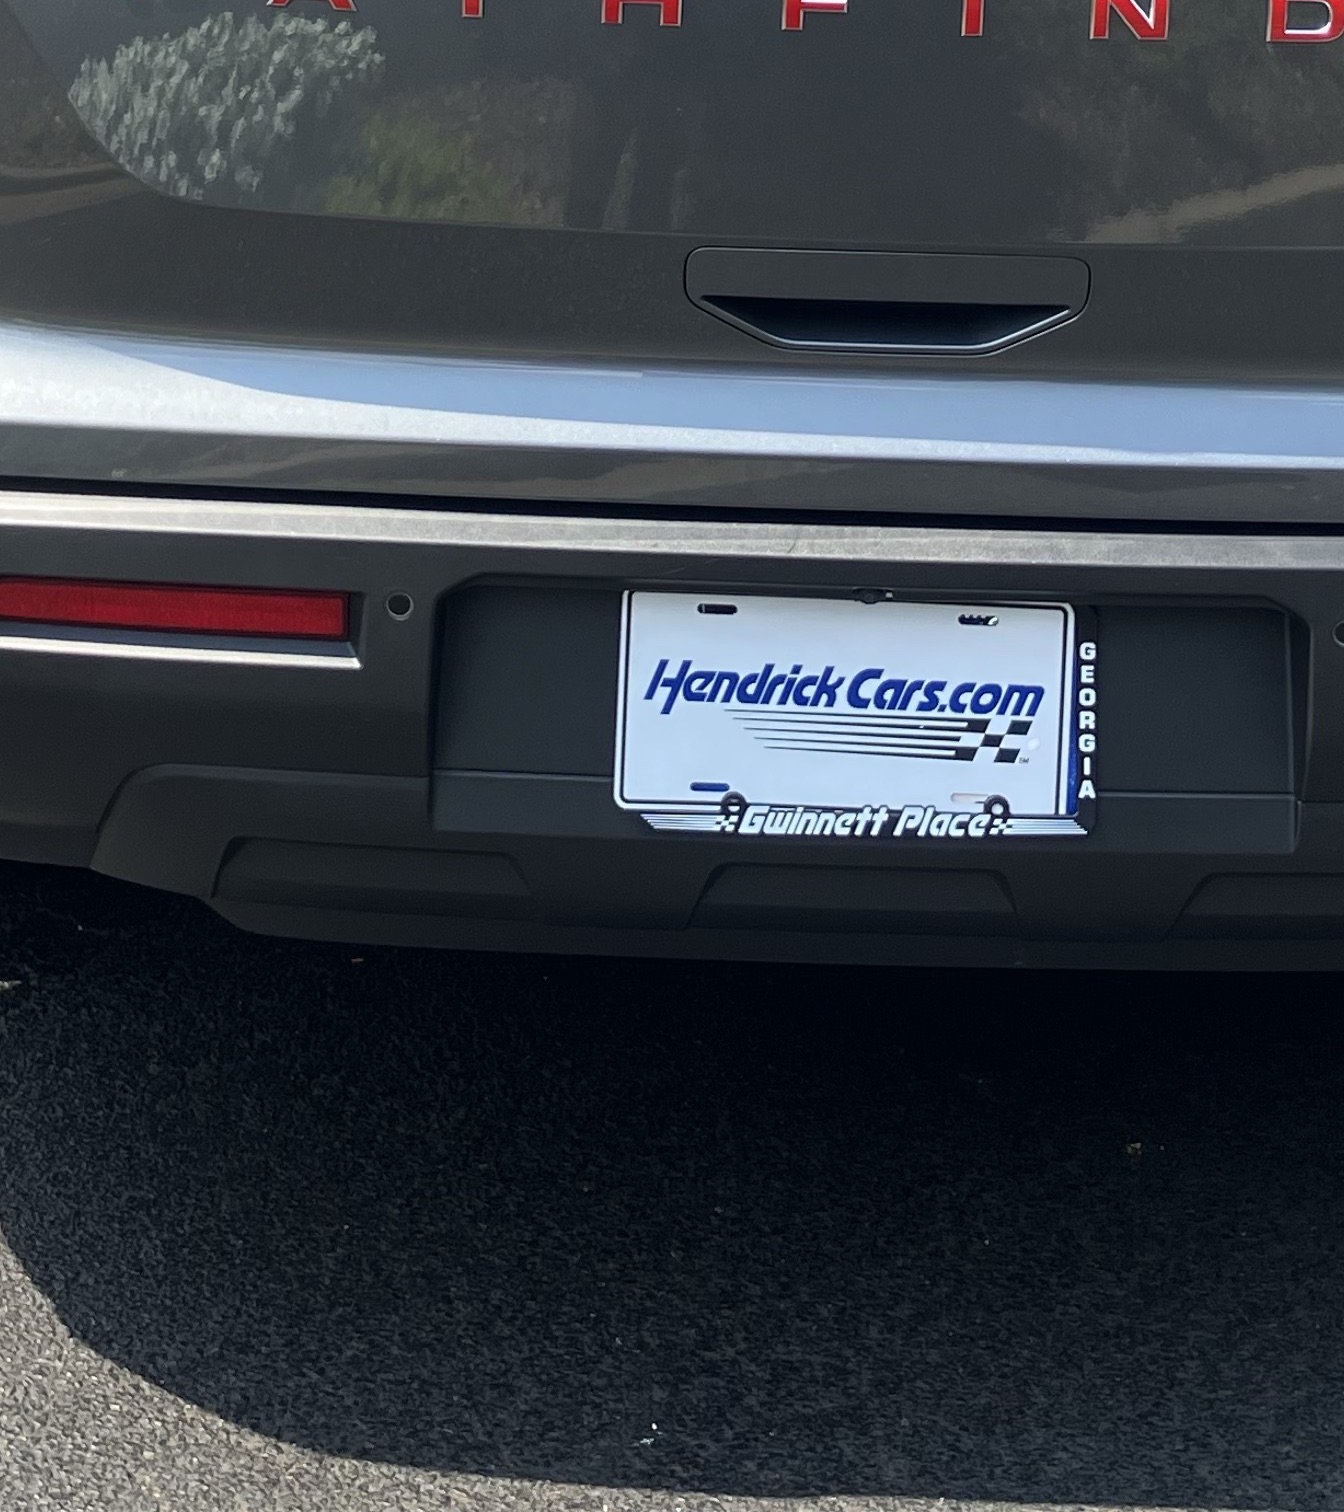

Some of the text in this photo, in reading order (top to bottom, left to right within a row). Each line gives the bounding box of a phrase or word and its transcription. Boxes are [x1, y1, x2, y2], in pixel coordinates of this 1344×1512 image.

[1077, 641, 1097, 799] GEORGIA
[738, 804, 992, 837] Gwinnett Place
